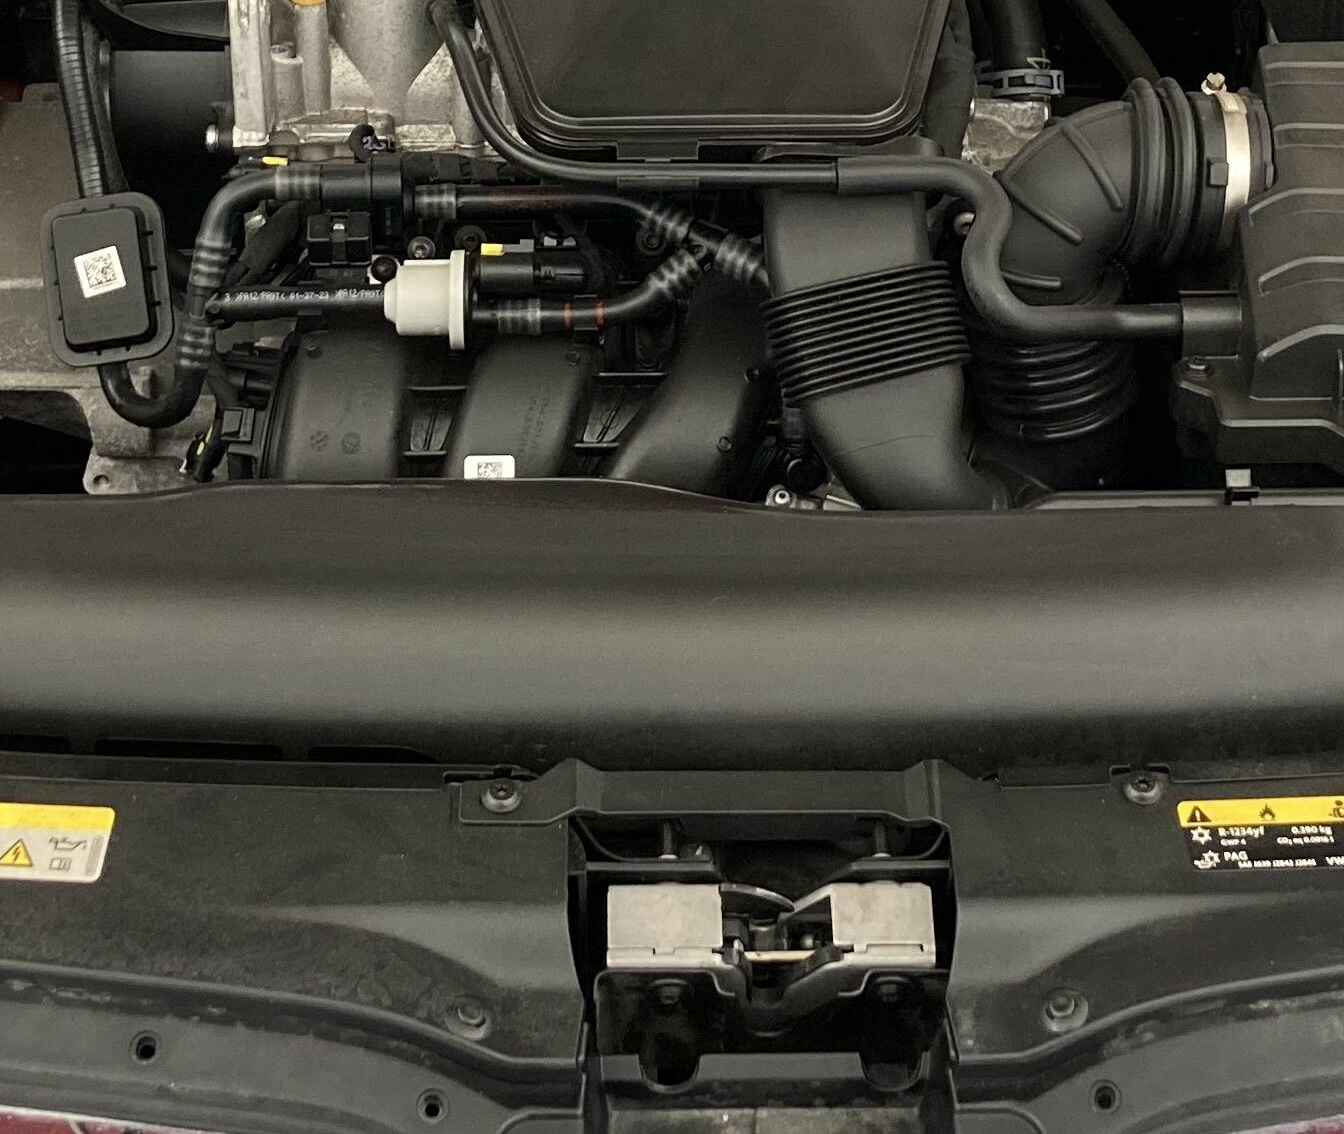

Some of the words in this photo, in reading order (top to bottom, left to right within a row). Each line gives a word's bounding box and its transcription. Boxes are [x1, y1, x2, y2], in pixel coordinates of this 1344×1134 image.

[1218, 825, 1265, 838] R-1234yf
[1318, 825, 1333, 836] kg
[1224, 851, 1248, 862] PAG
[1326, 856, 1344, 866] VW
